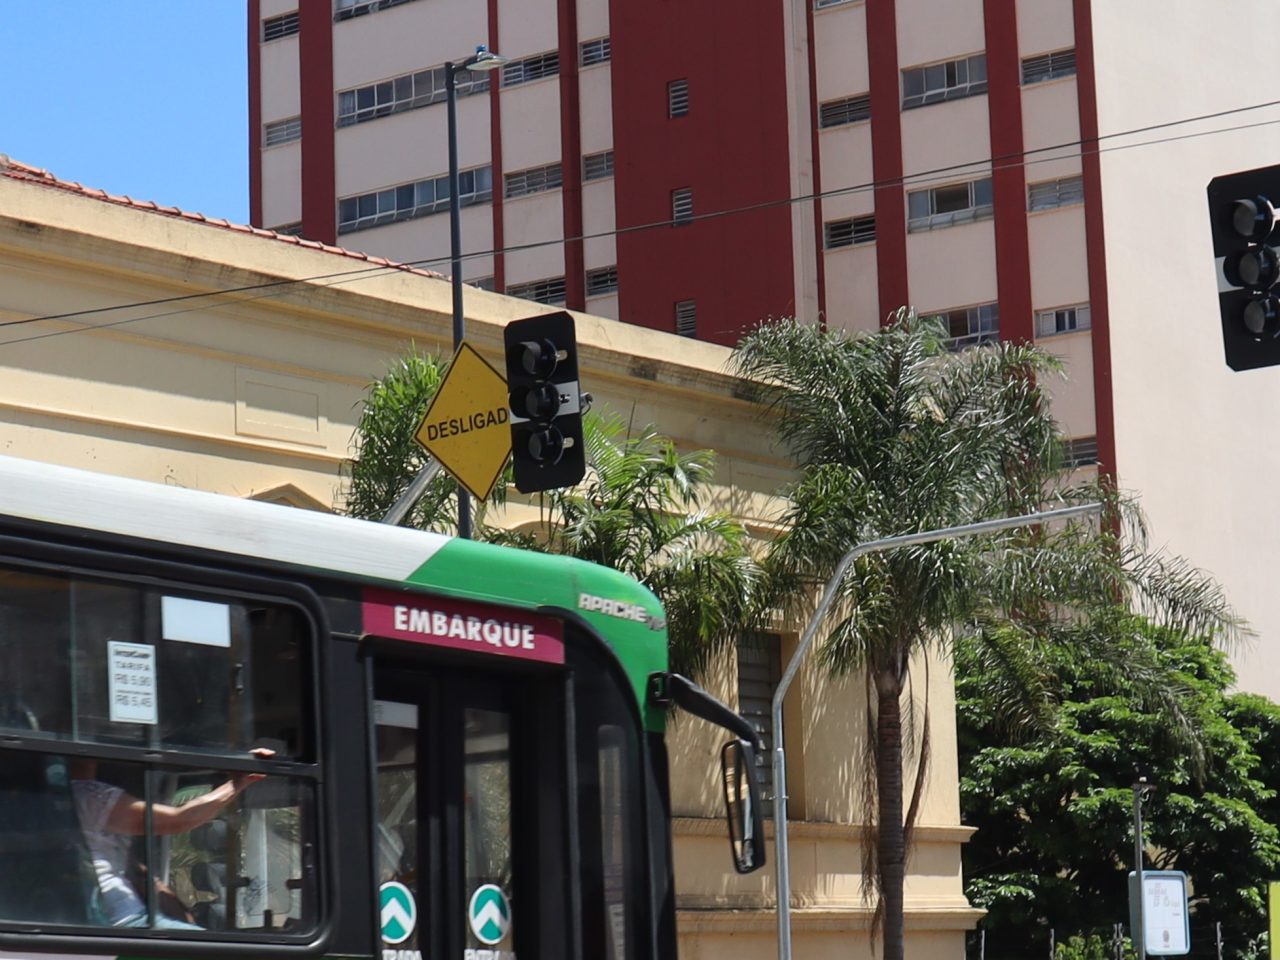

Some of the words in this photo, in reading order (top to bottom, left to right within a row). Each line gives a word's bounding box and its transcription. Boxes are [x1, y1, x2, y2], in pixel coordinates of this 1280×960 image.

[427, 407, 508, 441] DESLIGAD
[579, 593, 647, 622] APACHE
[394, 606, 535, 649] EMBARQUE
